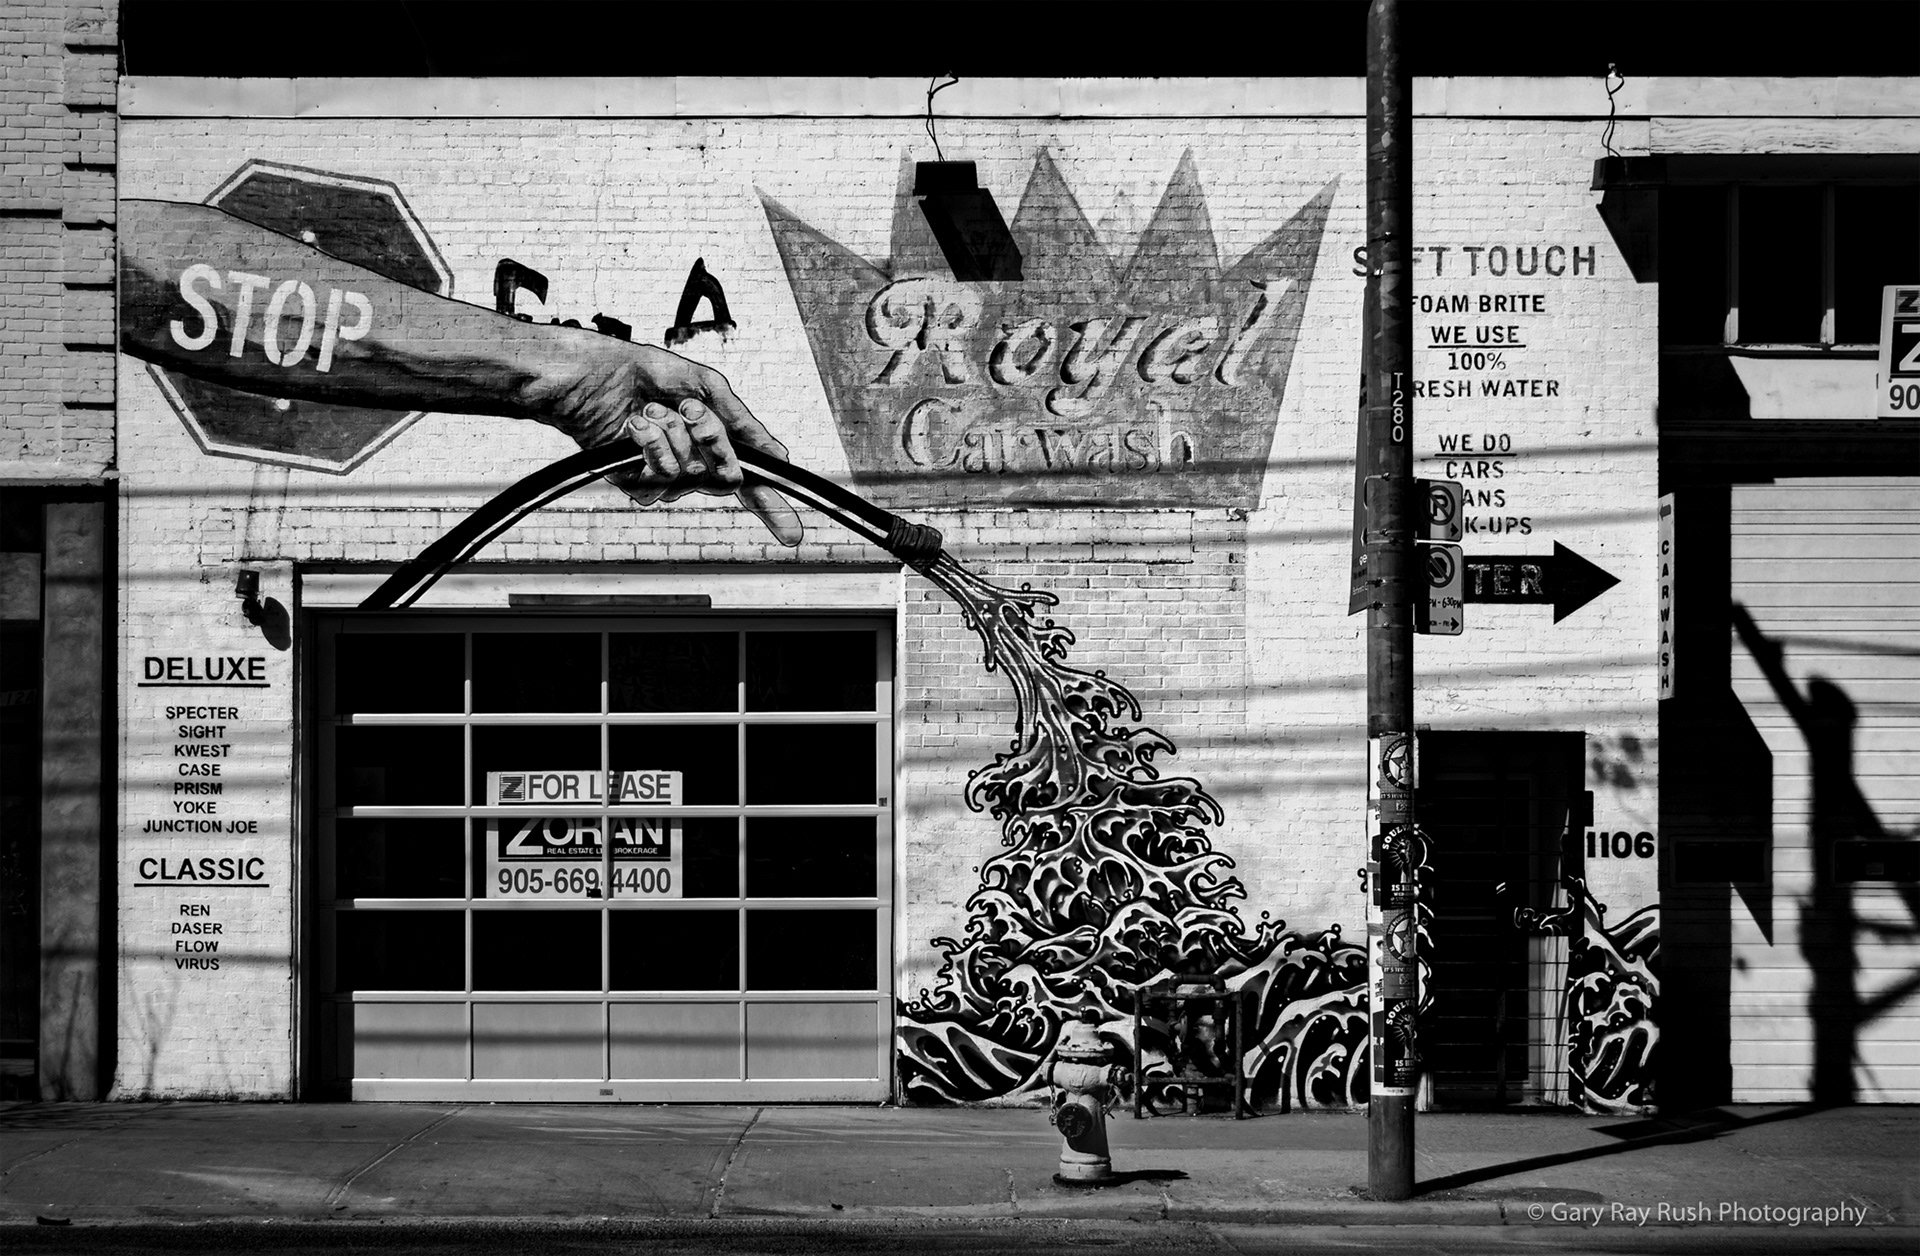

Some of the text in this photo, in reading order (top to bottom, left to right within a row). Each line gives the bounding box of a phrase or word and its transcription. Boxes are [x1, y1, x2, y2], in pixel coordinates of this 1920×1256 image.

[1462, 245, 1596, 277] TOUCH
[1479, 294, 1546, 313] BRITE
[170, 263, 373, 373] STOP
[1431, 325, 1520, 344] WE USE
[1448, 351, 1506, 371] 100%
[1412, 379, 1560, 398] RESH WATER
[1438, 433, 1511, 452] WE DO
[1445, 460, 1505, 479] CARS
[1463, 489, 1506, 508] ANS
[1465, 516, 1532, 536] K-UPS
[1467, 563, 1544, 596] TER
[1660, 539, 1670, 690] CARWASH
[144, 656, 266, 681] DELUXE
[165, 706, 239, 720] SPECTER
[178, 724, 227, 739] SIGHT
[174, 744, 231, 758] KWEST
[178, 763, 221, 777] CASE
[174, 782, 223, 796] PRISM
[529, 774, 580, 800] FOR
[172, 801, 217, 815] YOKE
[142, 819, 258, 834] JUNCTION JOE
[547, 847, 567, 855] REAL
[568, 847, 595, 855] ESTATE
[1586, 831, 1655, 859] 1106
[138, 857, 265, 882] CLASSIC
[498, 867, 672, 894] 905-669-4400
[180, 904, 211, 917] REN
[171, 922, 223, 935] DASER
[175, 940, 219, 953] FLOW
[174, 958, 220, 971] VIRUS
